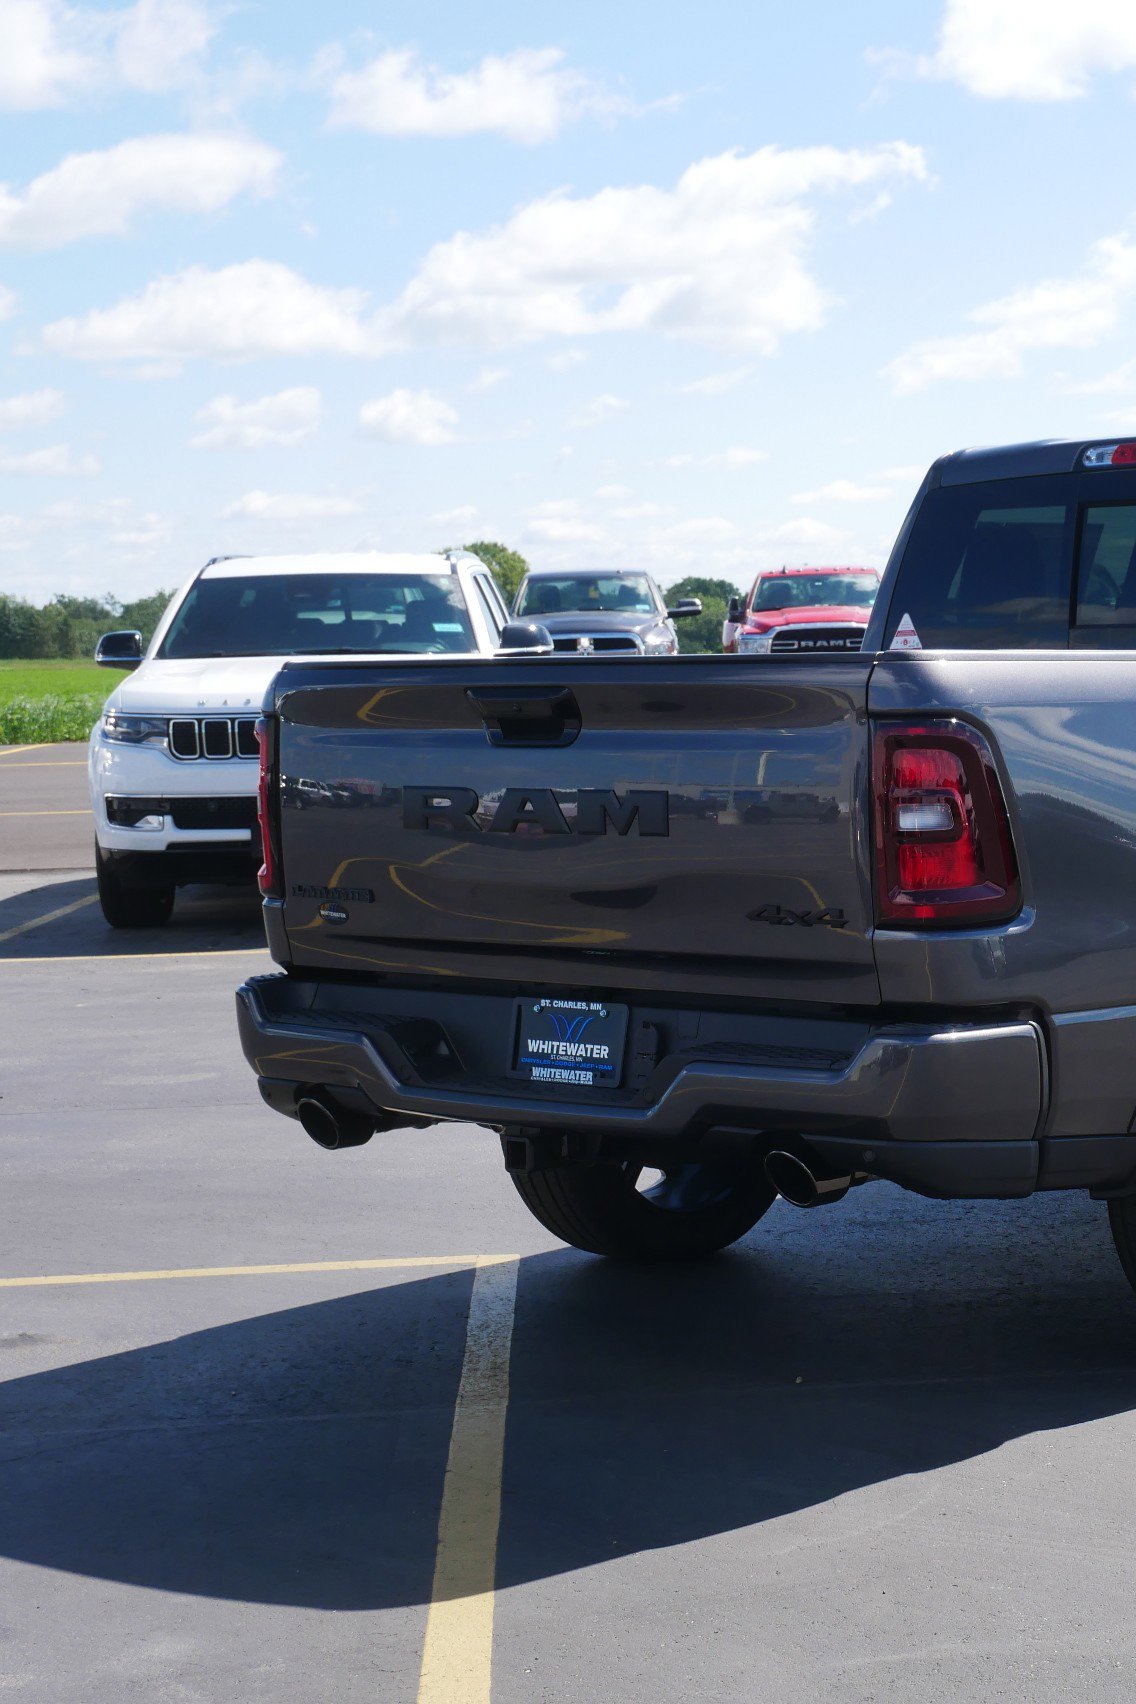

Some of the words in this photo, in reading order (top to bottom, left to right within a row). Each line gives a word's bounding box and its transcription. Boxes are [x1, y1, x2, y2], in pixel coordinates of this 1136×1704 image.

[800, 640, 844, 648] RAM
[402, 785, 670, 837] RAM
[745, 903, 850, 928] 4x4
[541, 999, 552, 1007] ST.
[553, 1000, 588, 1010] CHARLES,
[527, 1039, 609, 1059] WHITEWATER
[532, 1066, 593, 1081] WHITEWATER
